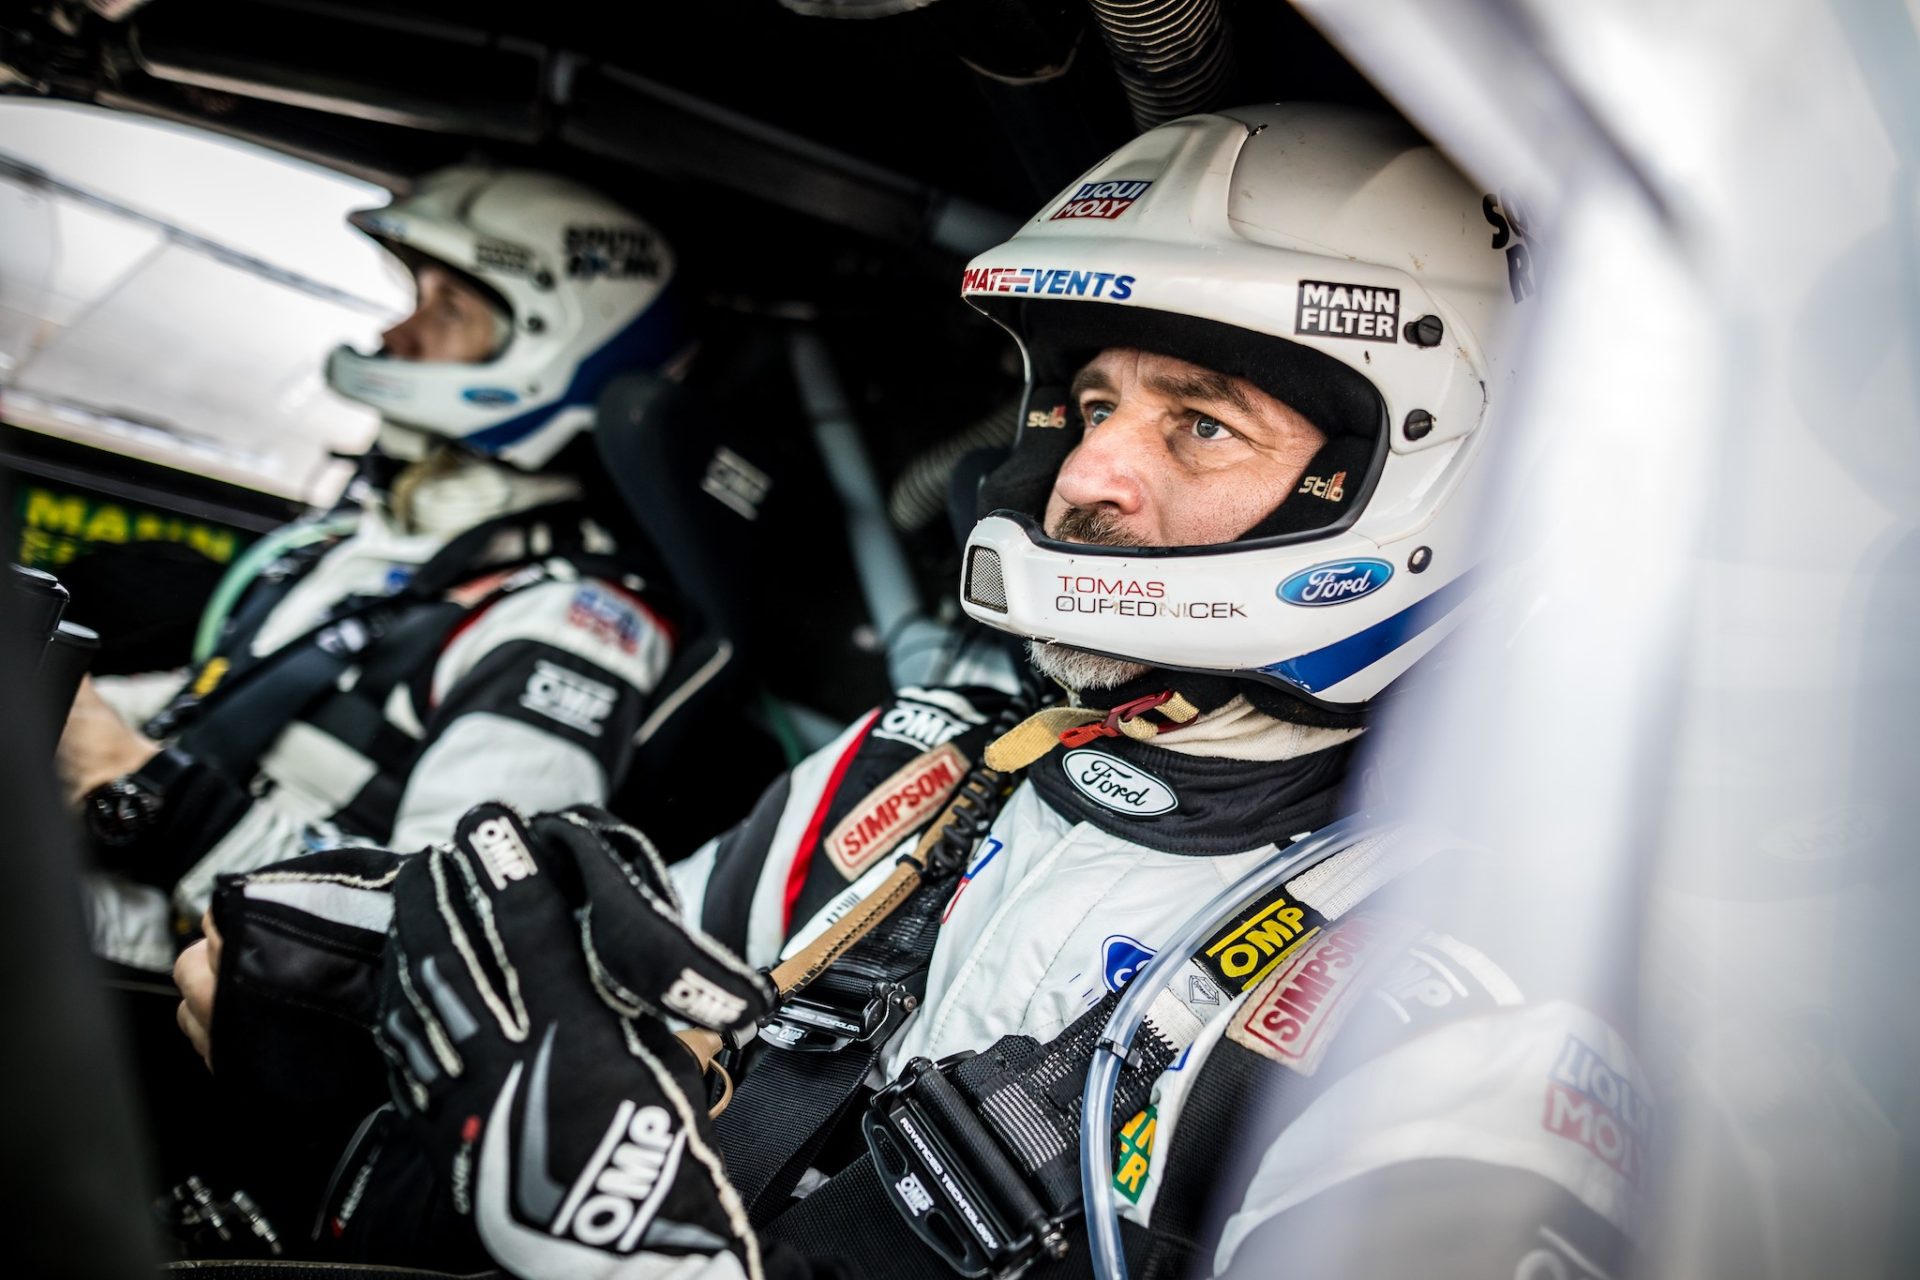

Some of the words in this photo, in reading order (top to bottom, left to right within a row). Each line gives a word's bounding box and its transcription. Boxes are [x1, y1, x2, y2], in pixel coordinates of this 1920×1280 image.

[1054, 200, 1131, 217] MOLY
[1073, 182, 1149, 200] LIQUI
[1303, 284, 1395, 314] MANN
[1301, 308, 1394, 337] FILTER
[1058, 576, 1165, 598] TOMAS
[1302, 566, 1372, 601] Ford
[524, 669, 614, 722] OMP
[1081, 760, 1150, 806] Ford
[843, 762, 954, 856] SIMPSON
[476, 819, 531, 881] OMP
[1220, 907, 1304, 977] OMP
[668, 979, 742, 1024] OMP
[1262, 917, 1374, 1043] SIMPSO
[572, 1105, 673, 1245] OMP
[900, 1117, 943, 1175] ADVANCED
[942, 1173, 998, 1249] TECHNOLOGY
[900, 1176, 930, 1211] OMP
